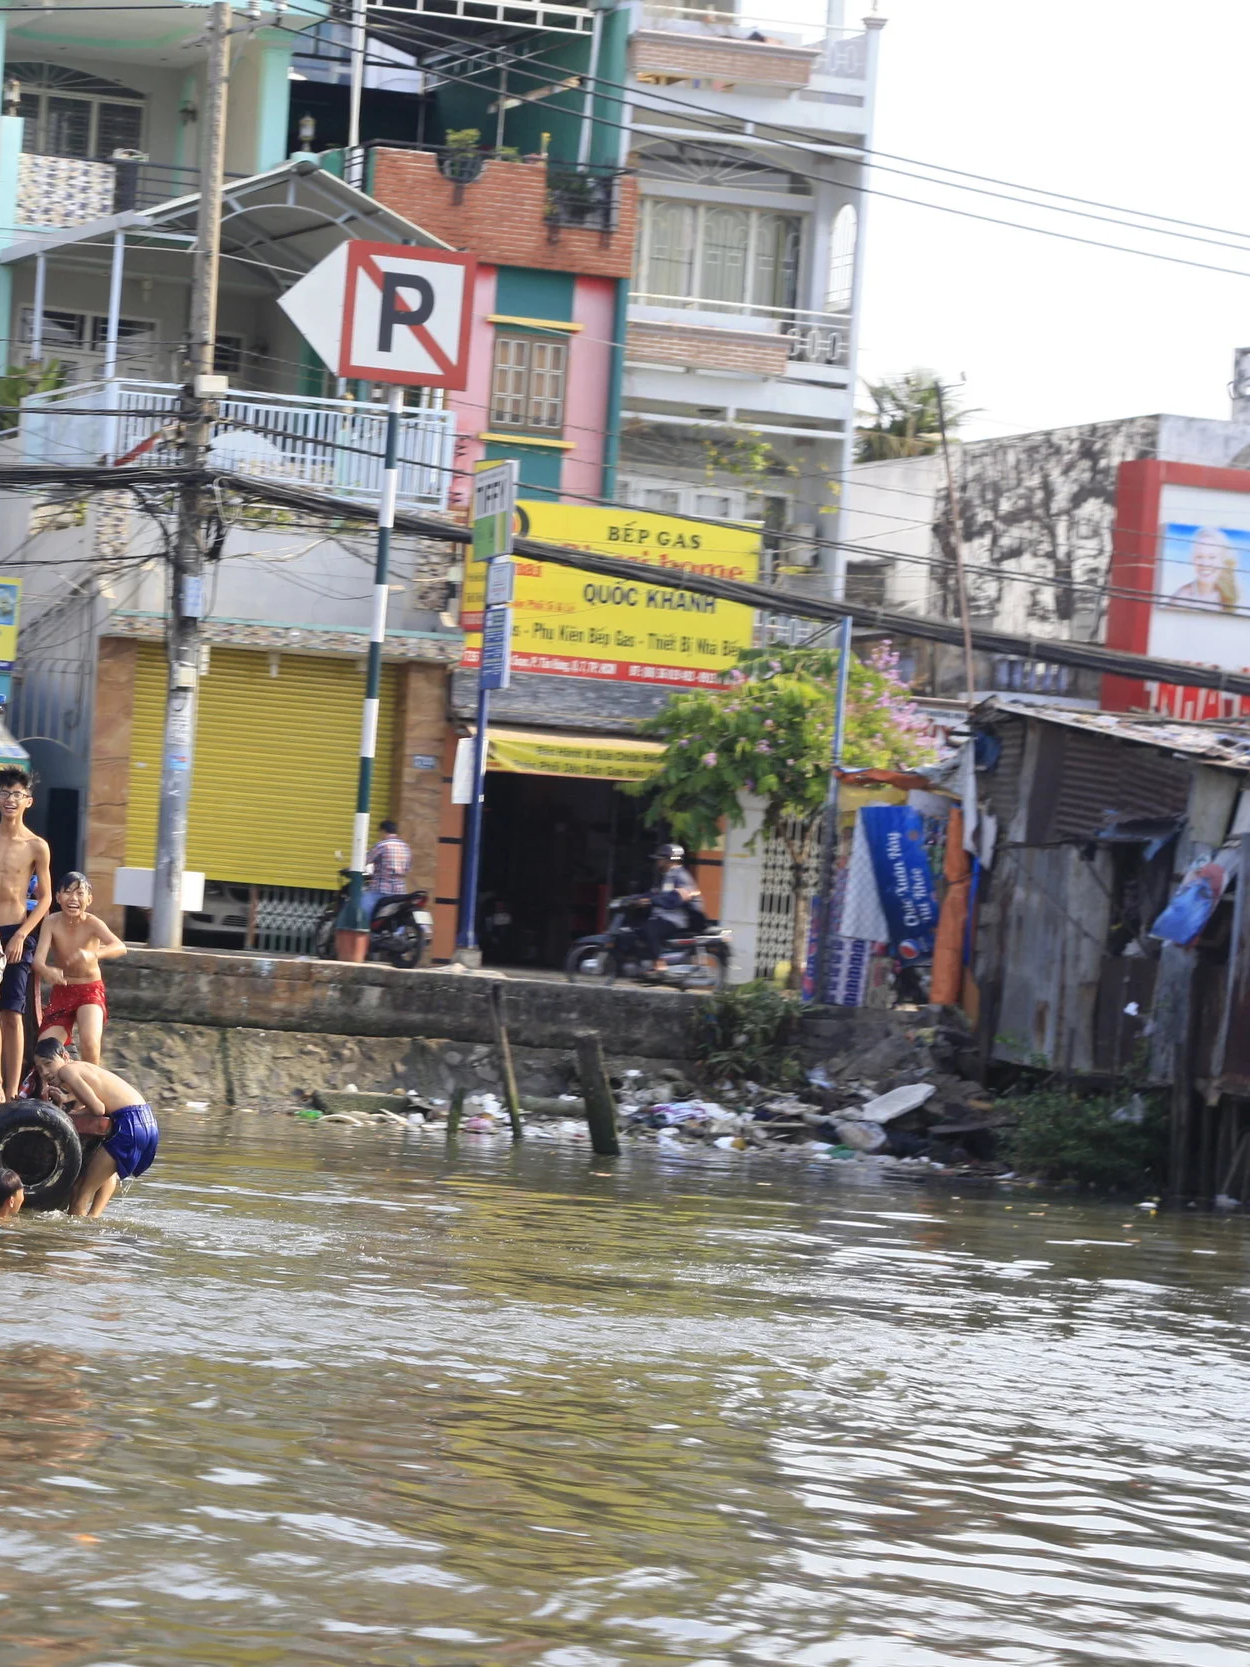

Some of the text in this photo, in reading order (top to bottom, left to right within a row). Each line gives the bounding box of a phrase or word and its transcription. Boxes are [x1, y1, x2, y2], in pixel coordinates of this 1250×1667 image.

[377, 271, 434, 352] P
[656, 531, 701, 549] GAS
[583, 579, 639, 607] QUỐC
